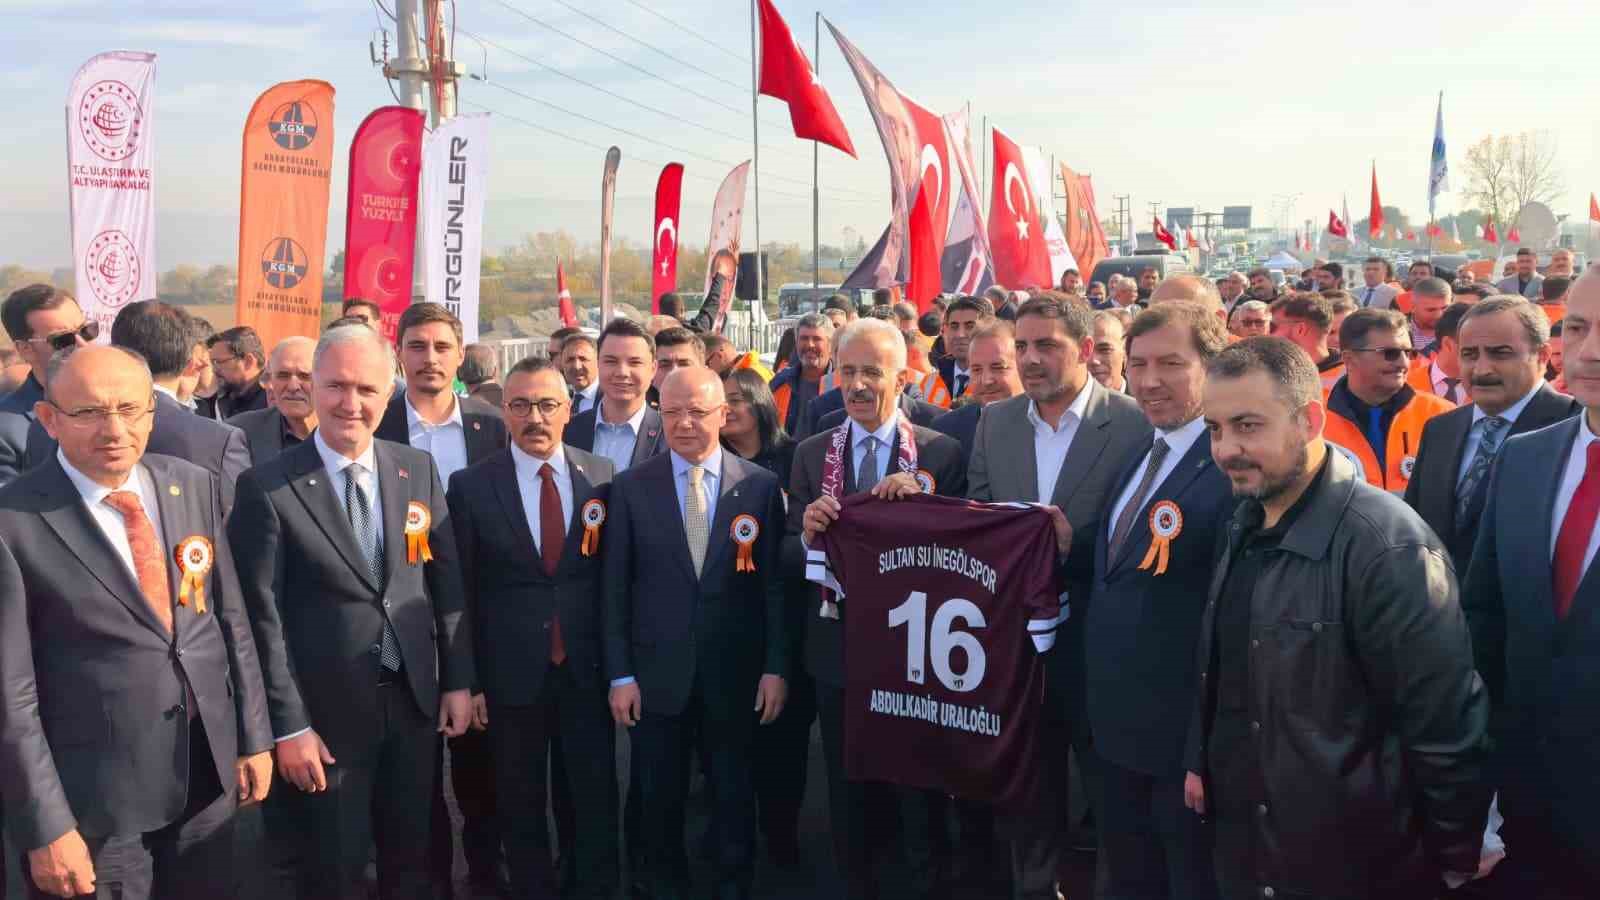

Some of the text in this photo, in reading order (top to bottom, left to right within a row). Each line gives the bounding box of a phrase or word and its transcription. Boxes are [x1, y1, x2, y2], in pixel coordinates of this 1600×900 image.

[280, 121, 305, 135] KGM
[270, 262, 295, 273] KGM
[879, 543, 997, 594] SULTAN SU İNEGÖLSPOR
[888, 591, 987, 692] 16
[870, 689, 1000, 737] ABDULKADİR URALOĞLU
